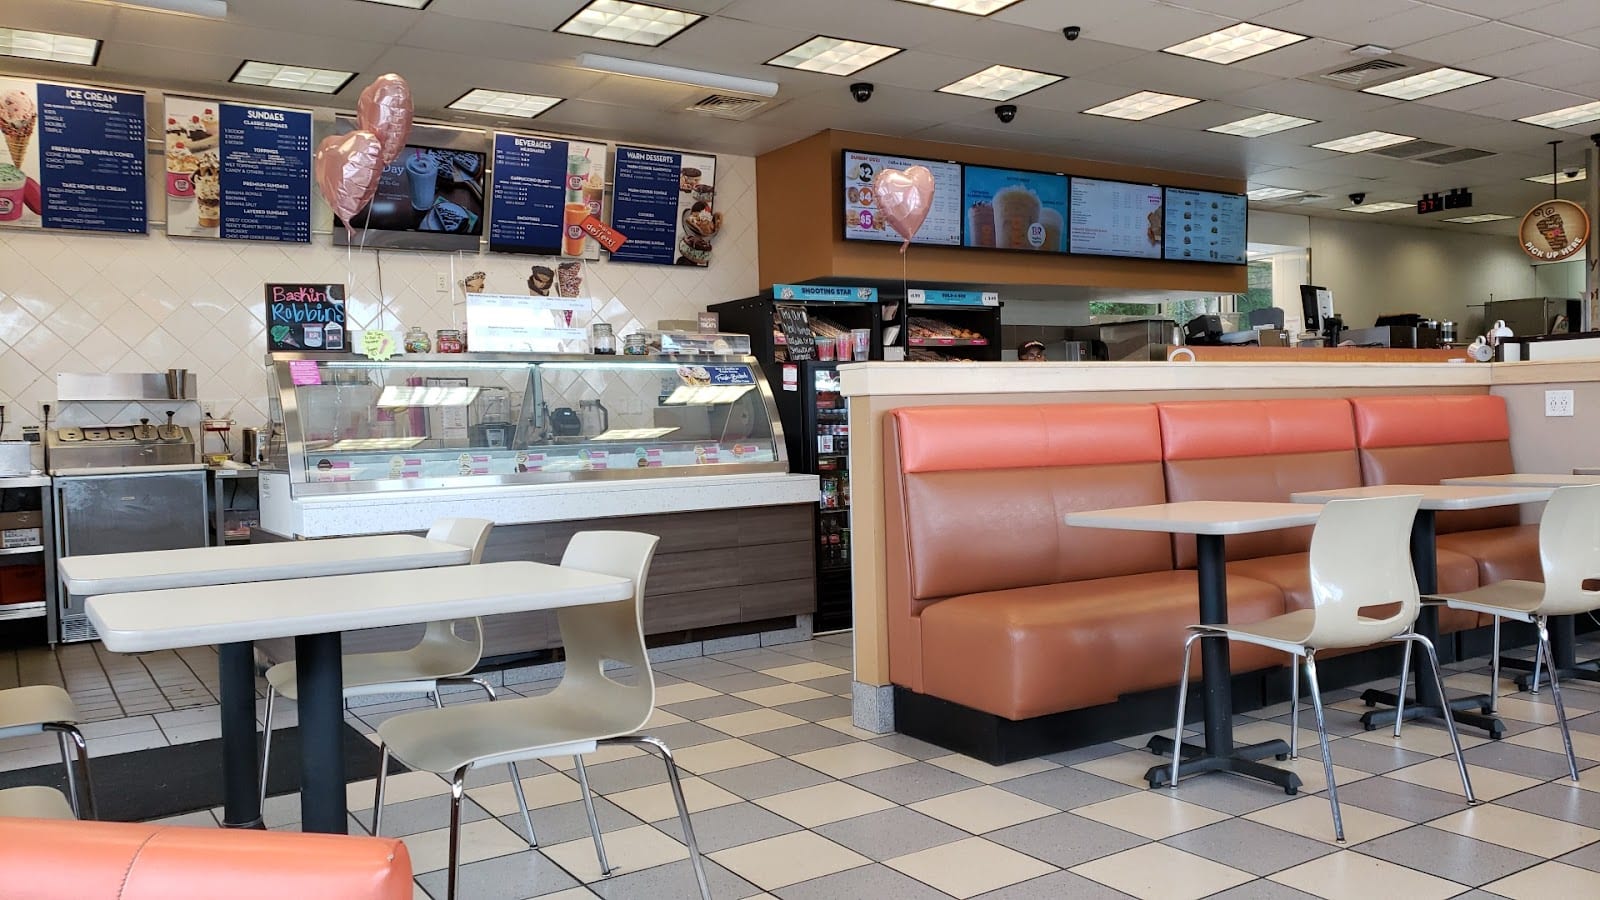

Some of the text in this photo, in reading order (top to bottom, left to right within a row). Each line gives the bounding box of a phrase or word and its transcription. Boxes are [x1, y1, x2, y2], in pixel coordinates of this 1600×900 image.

[66, 89, 118, 103] ICE CREAM
[248, 110, 284, 121] SUNDAES
[515, 138, 551, 149] BEVERAGES
[627, 152, 673, 163] WARM DESSERTS
[383, 164, 404, 175] Day
[860, 167, 871, 178] $2
[860, 191, 871, 202] $4
[861, 214, 871, 225] $5
[1525, 241, 1544, 257] PICK
[1561, 237, 1582, 255] HERE
[273, 286, 326, 302] Baskin
[272, 302, 344, 323] Robbins
